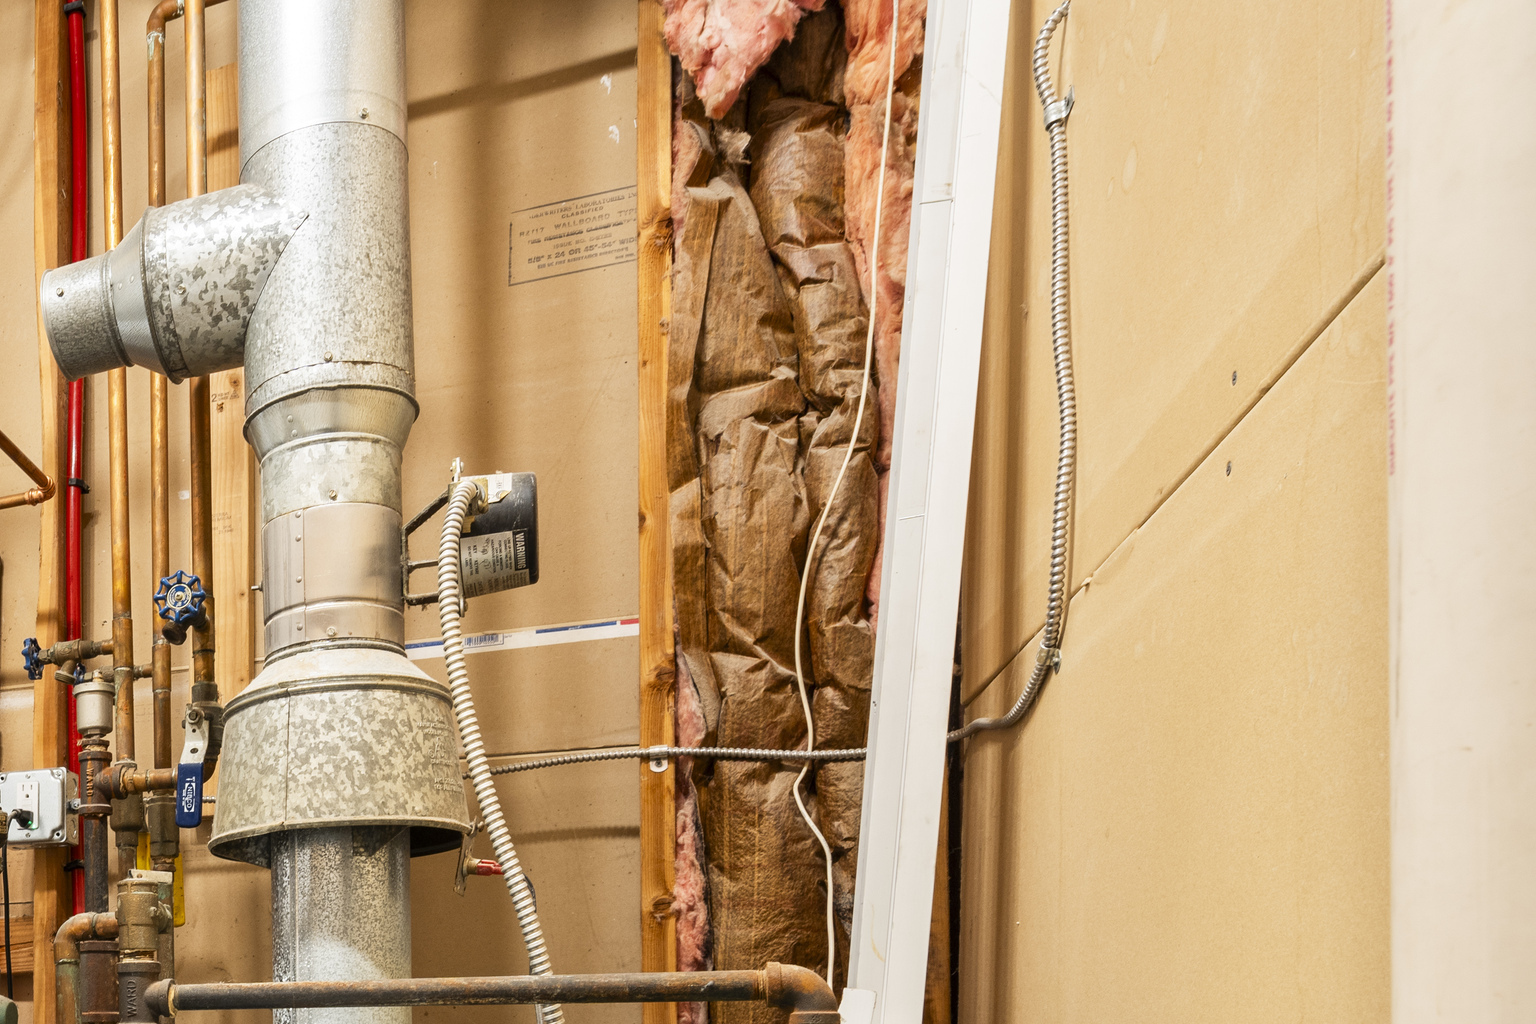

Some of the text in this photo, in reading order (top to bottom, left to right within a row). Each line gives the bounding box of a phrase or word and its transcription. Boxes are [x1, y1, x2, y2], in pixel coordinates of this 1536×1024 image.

[554, 213, 610, 230] WALLBOARD
[562, 206, 604, 218] CLASSIFIED
[554, 250, 565, 258] 24
[515, 532, 526, 569] WARNING
[86, 768, 94, 798] WARD
[126, 979, 138, 1018] WARD
